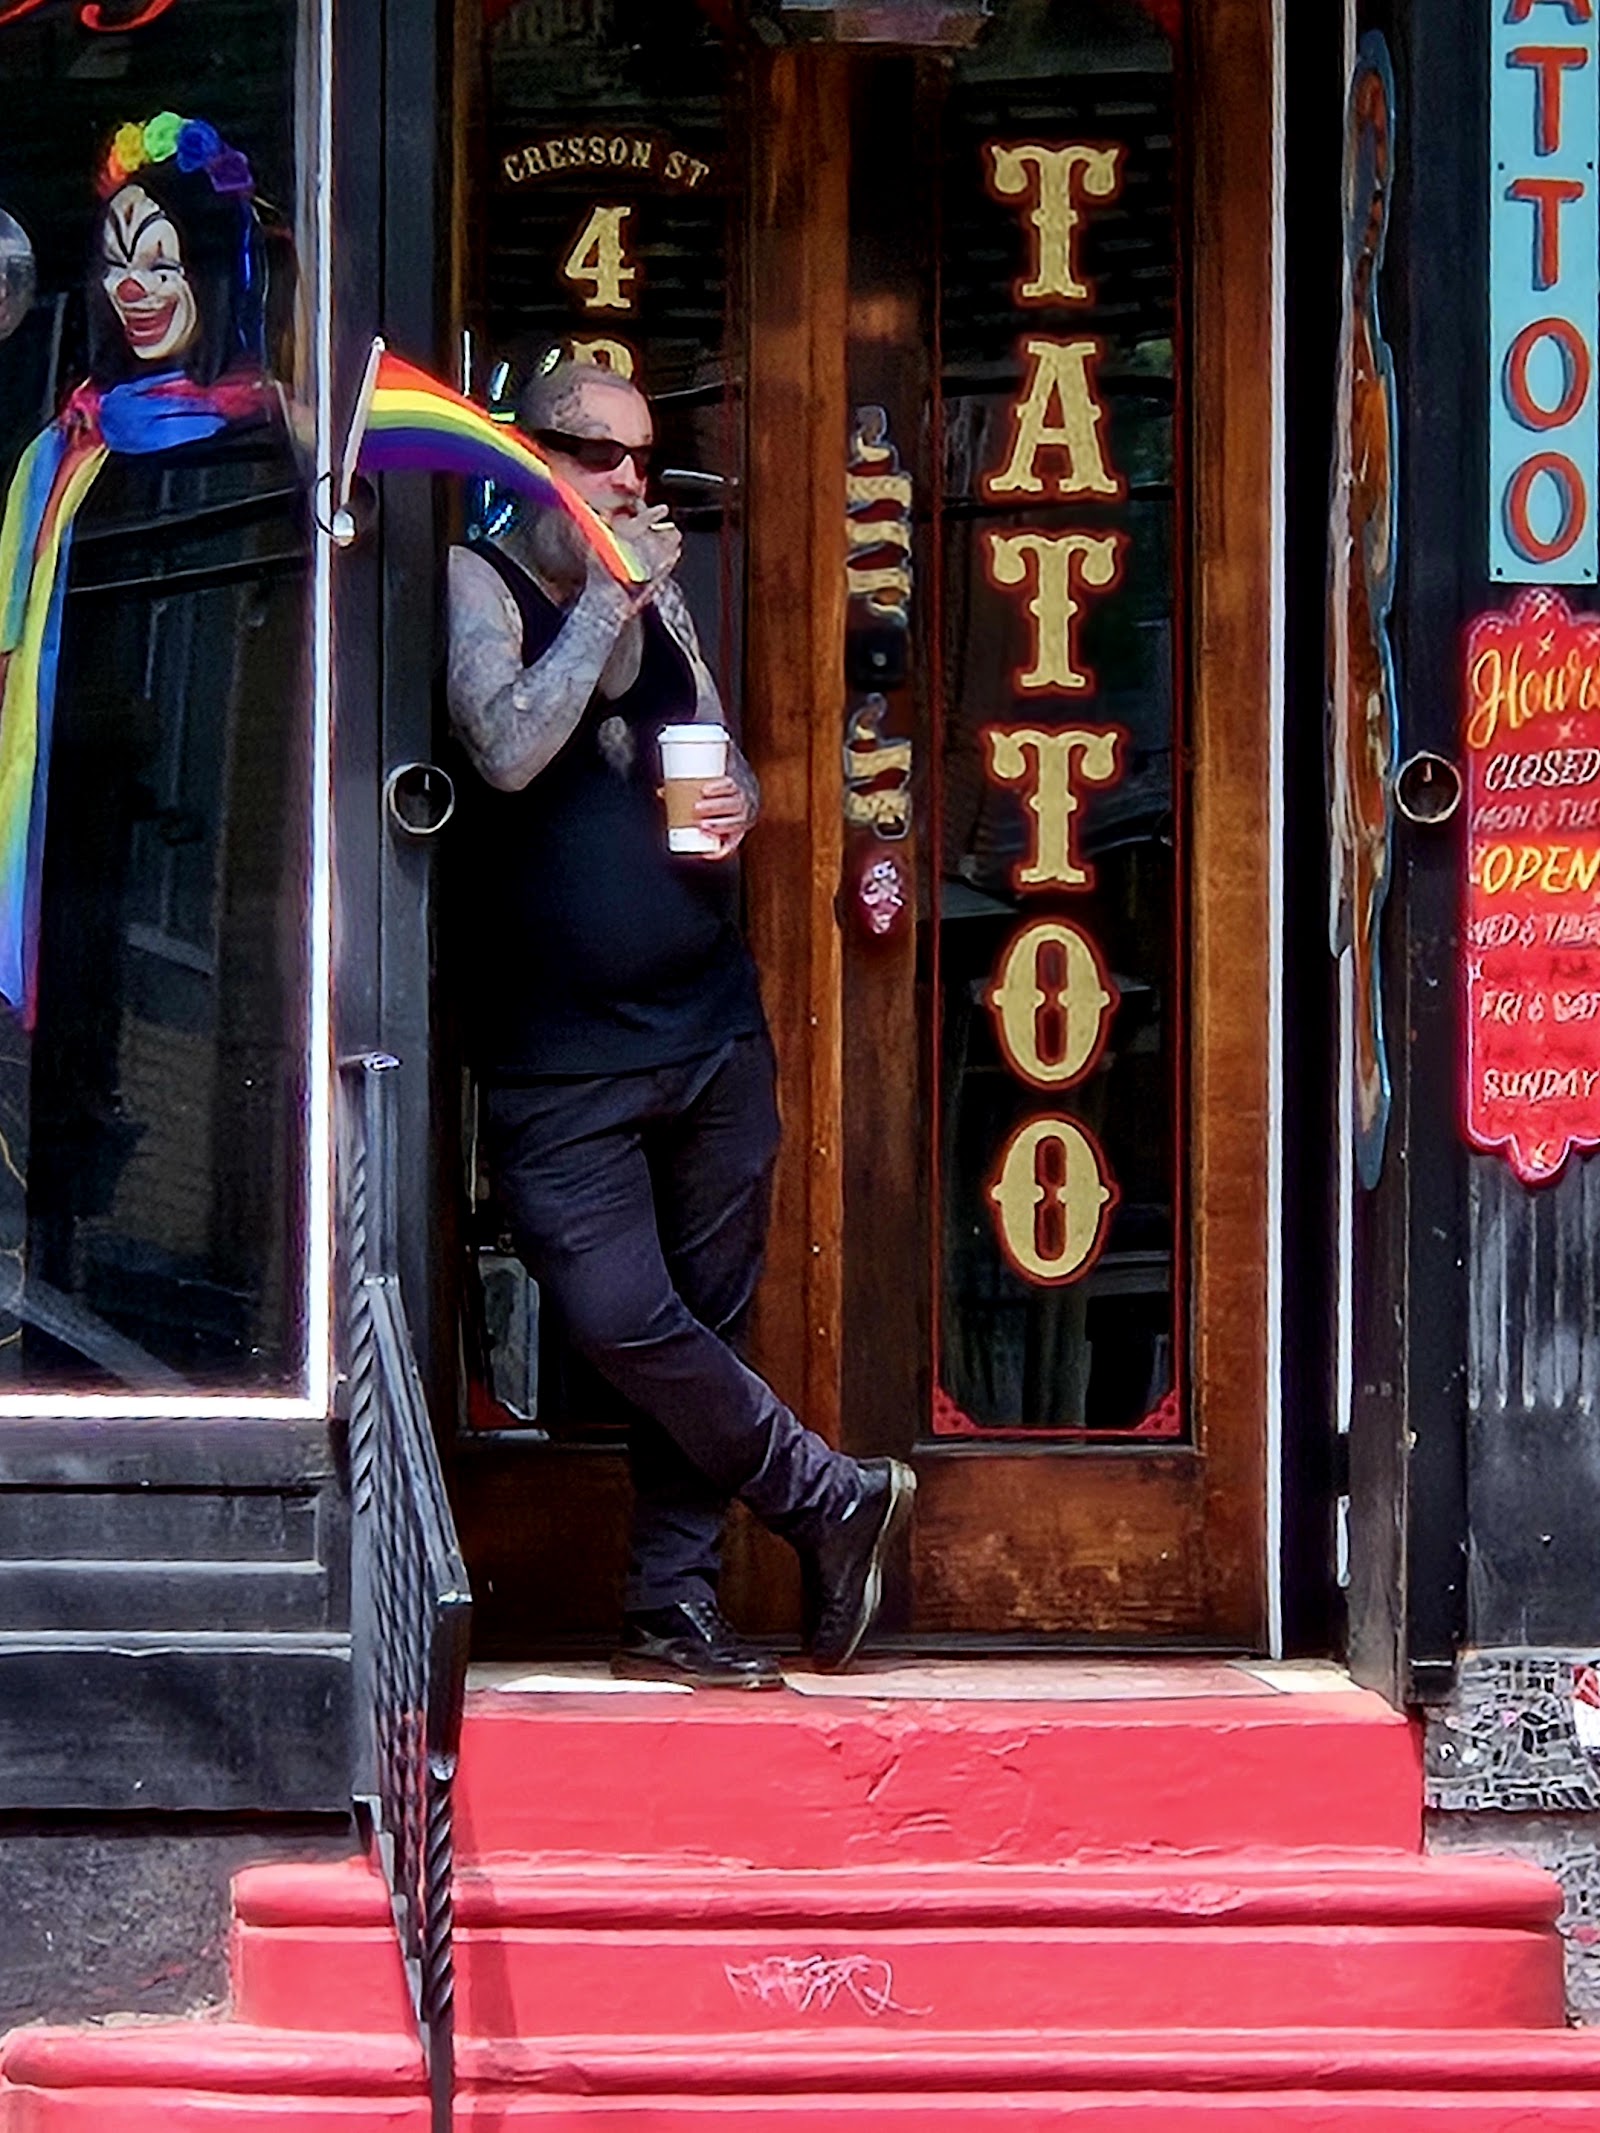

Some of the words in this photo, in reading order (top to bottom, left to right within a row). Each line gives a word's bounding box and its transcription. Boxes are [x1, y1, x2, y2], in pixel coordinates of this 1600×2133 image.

[504, 137, 651, 183] CRESSON
[665, 150, 710, 187] ST
[1503, 0, 1591, 564] TTOO
[988, 141, 1122, 1284] TATTOO
[1485, 749, 1600, 791] CLOSED
[1483, 845, 1600, 894] OPEN
[1483, 1068, 1600, 1103] SUNDAY
